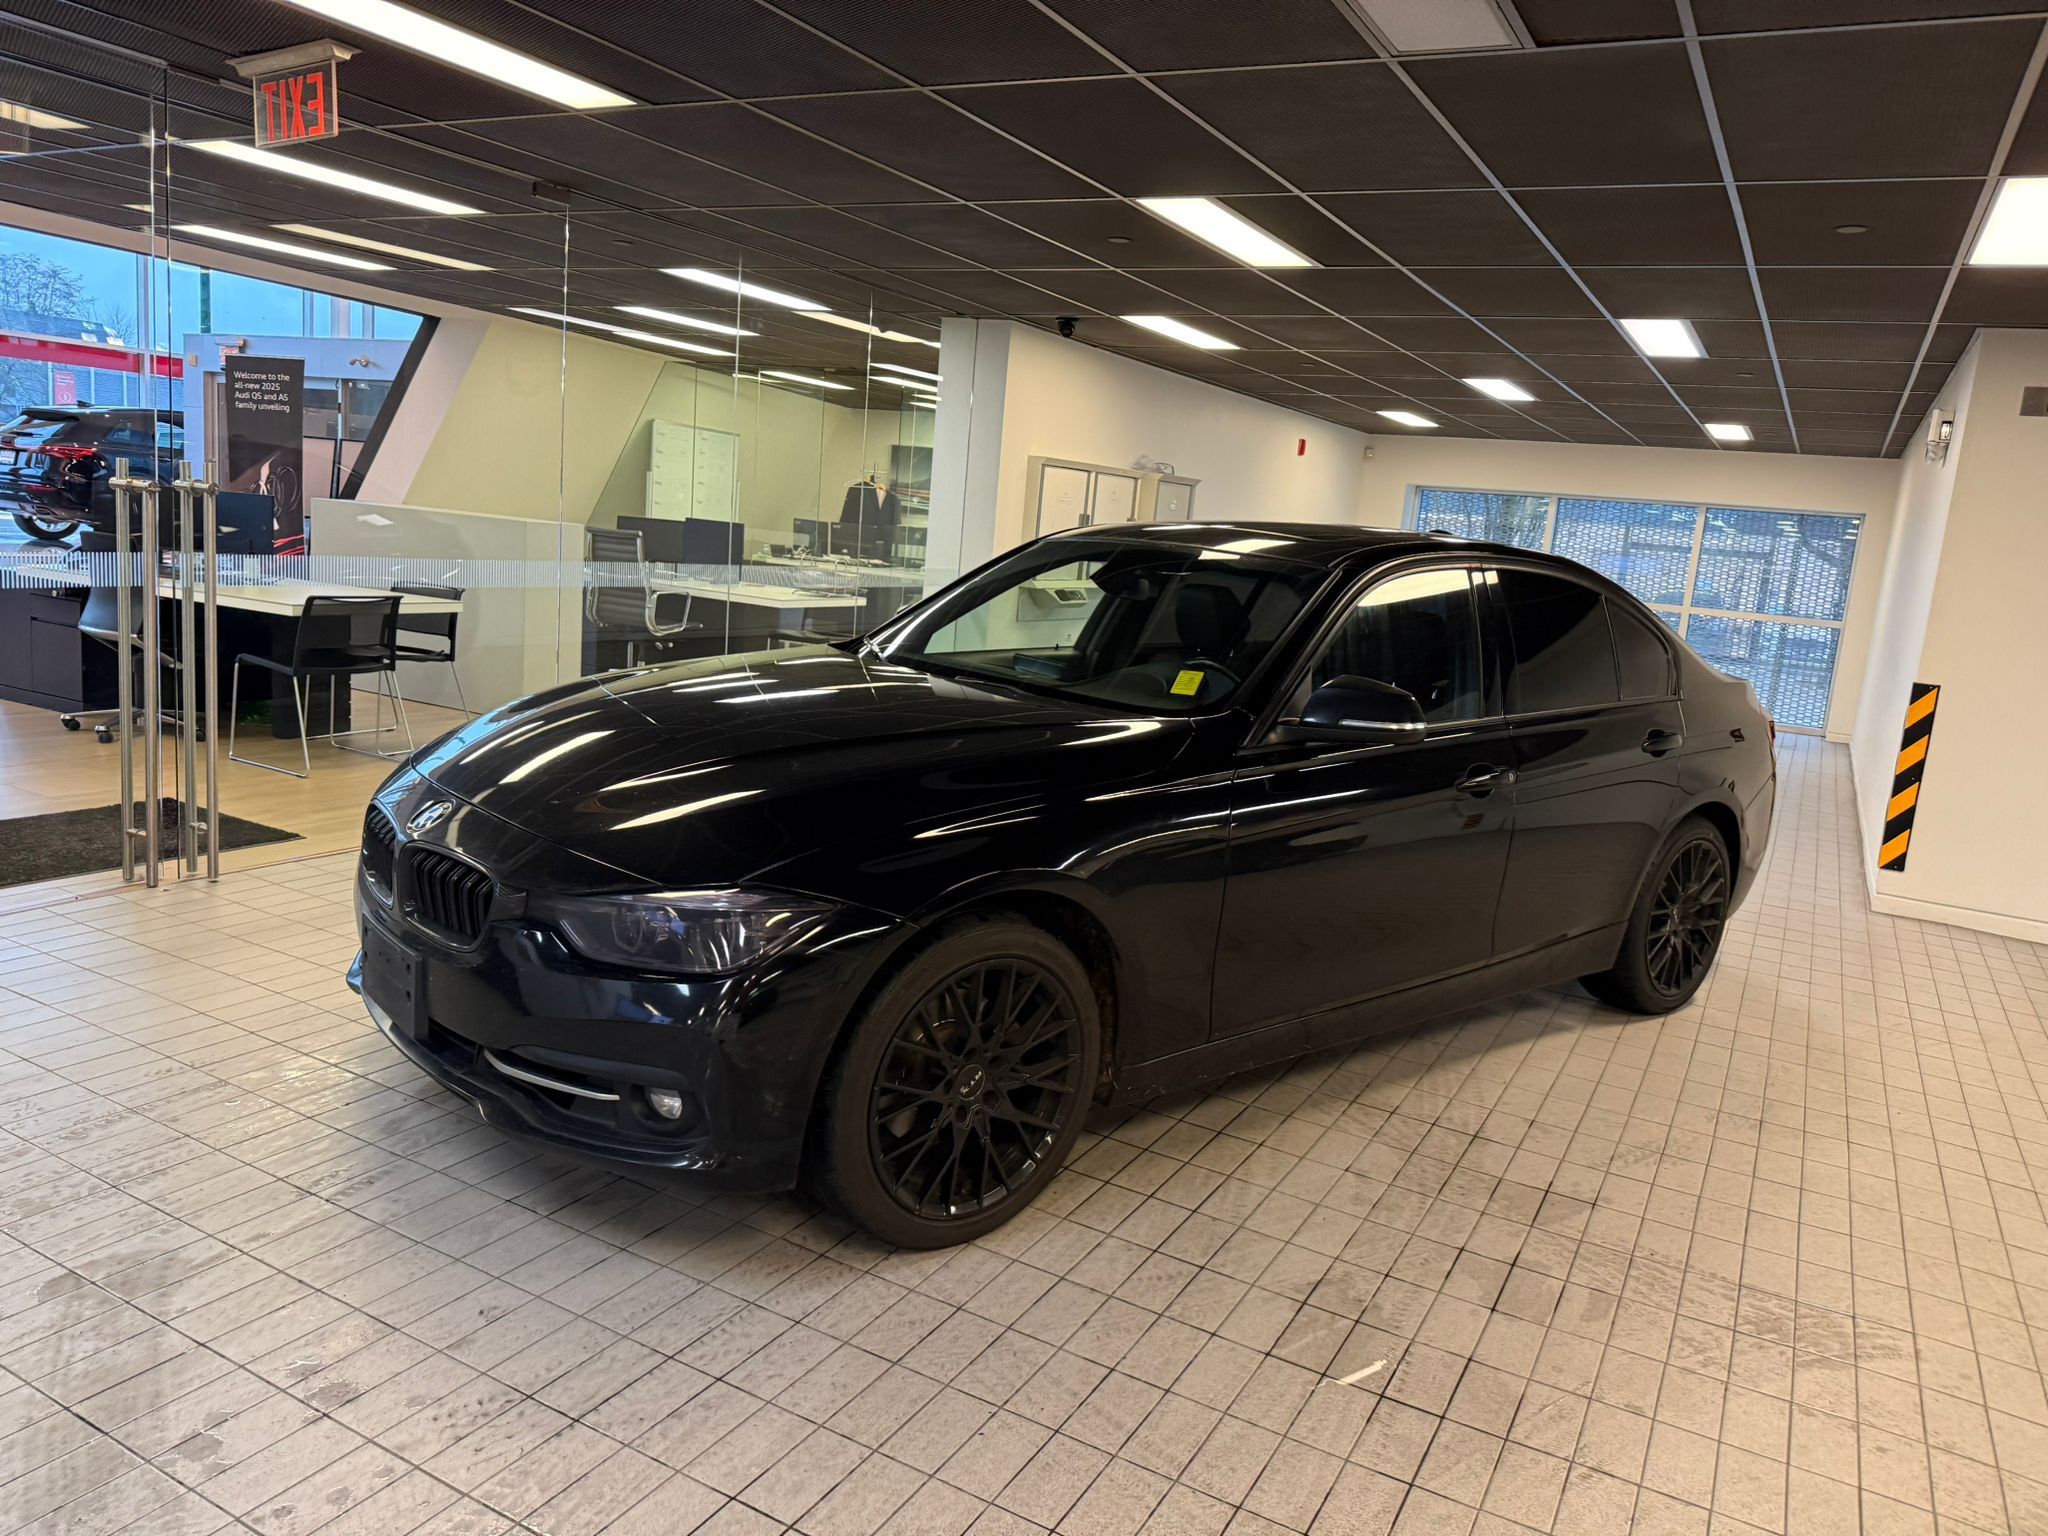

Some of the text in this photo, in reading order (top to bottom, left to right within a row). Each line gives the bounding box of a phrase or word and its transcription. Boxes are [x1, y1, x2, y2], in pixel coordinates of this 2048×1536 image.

[233, 371, 267, 380] Welcome
[277, 373, 290, 381] the
[234, 381, 281, 391] all-new 2025
[234, 391, 289, 401] Audi Q5 and A5
[235, 401, 290, 413] family unveiling
